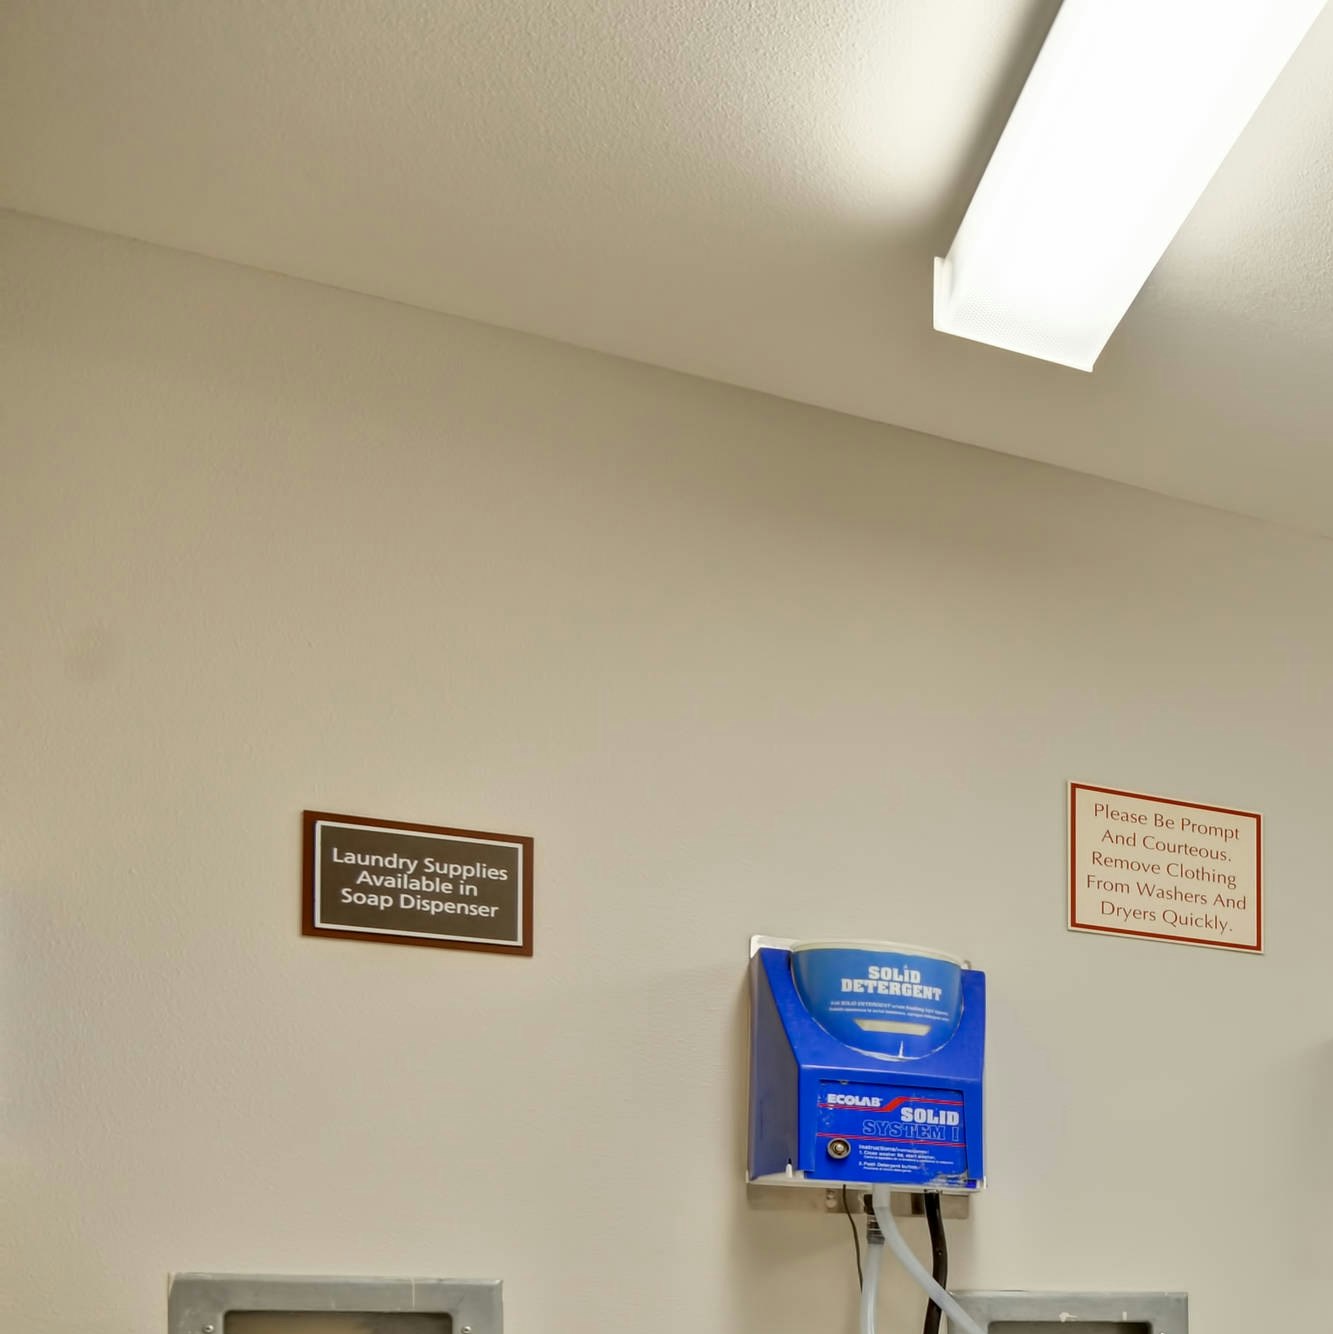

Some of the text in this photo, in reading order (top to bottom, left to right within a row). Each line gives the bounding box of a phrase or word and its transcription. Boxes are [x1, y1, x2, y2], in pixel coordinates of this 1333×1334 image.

[1094, 803, 1239, 843] Please Be Prompt
[1101, 830, 1232, 862] And Courteous.
[332, 847, 508, 881] Laundry Supplies
[1092, 851, 1237, 890] Remove Clothing
[356, 870, 478, 897] Available in
[1087, 875, 1246, 910] From Washers And
[341, 888, 499, 918] Soap Dispenser
[1101, 901, 1233, 935] Dryers Quickly.
[841, 978, 942, 1001] DETERGENT
[827, 1093, 881, 1107] ECOLAB
[863, 1119, 946, 1140] SYSTEM
[901, 1107, 960, 1125] SOLID
